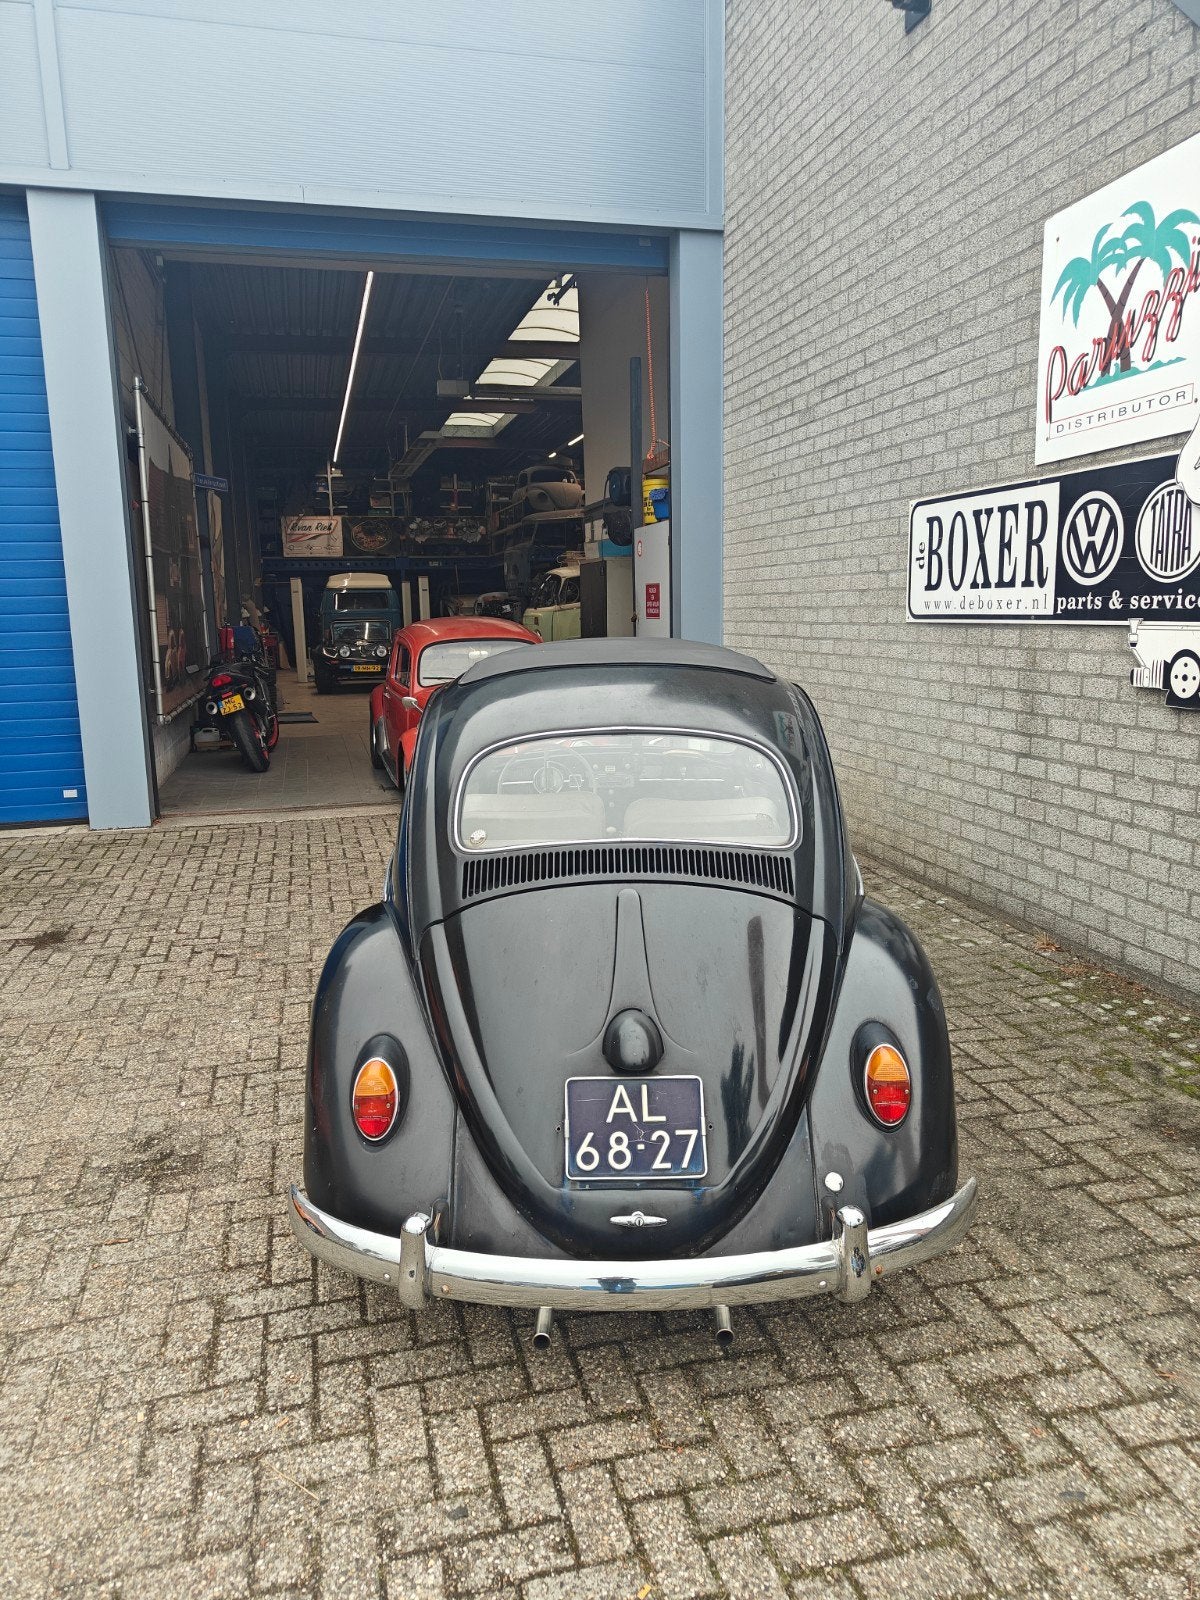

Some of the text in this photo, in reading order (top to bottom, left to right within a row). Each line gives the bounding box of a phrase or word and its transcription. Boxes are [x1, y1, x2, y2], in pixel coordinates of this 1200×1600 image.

[1046, 236, 1200, 424] Paruzzi
[1056, 390, 1187, 433] DISTRIBUTOR
[924, 499, 1049, 591] BOXER
[1151, 489, 1192, 573] TATRA
[915, 541, 926, 570] de
[924, 594, 1048, 610] www.deboxer.nl
[1056, 588, 1200, 614] parts & servic
[606, 1084, 667, 1123] AL
[576, 1130, 698, 1171] 68-27
